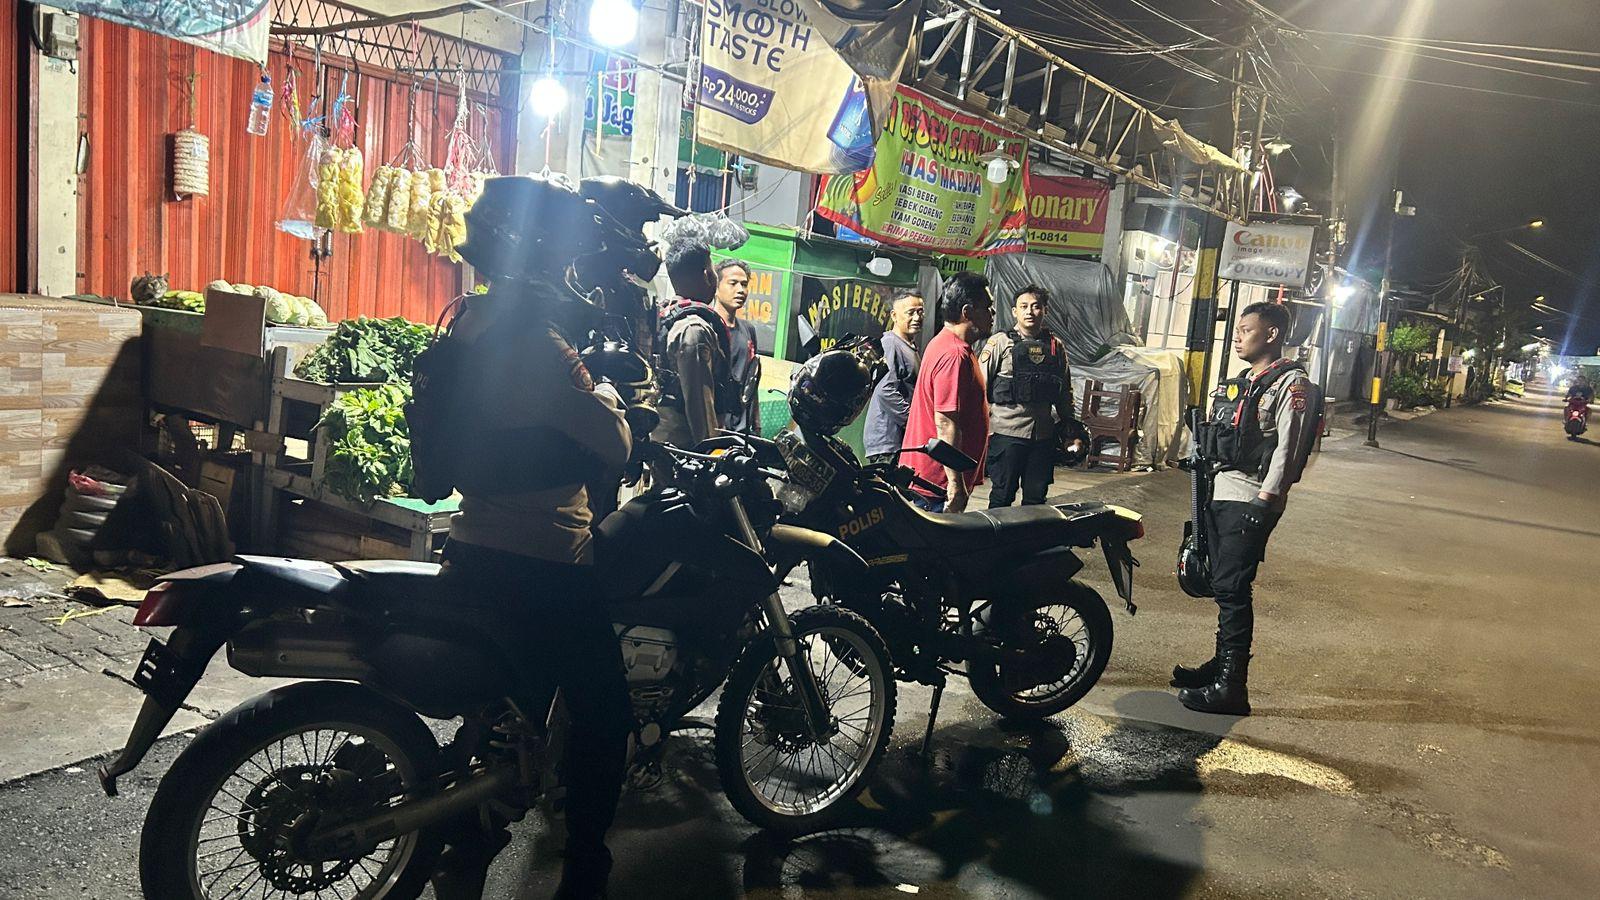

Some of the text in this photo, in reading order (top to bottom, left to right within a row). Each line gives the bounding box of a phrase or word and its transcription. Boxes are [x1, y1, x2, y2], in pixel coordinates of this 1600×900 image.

[708, 0, 811, 52] SMOOTH
[707, 19, 785, 73] TASTE
[916, 188, 938, 205] BEBEK
[918, 204, 943, 220] GORENG
[911, 216, 937, 232] GORENG
[1233, 230, 1307, 249] Canon
[941, 258, 968, 272] Print
[838, 506, 884, 541] POLISI
